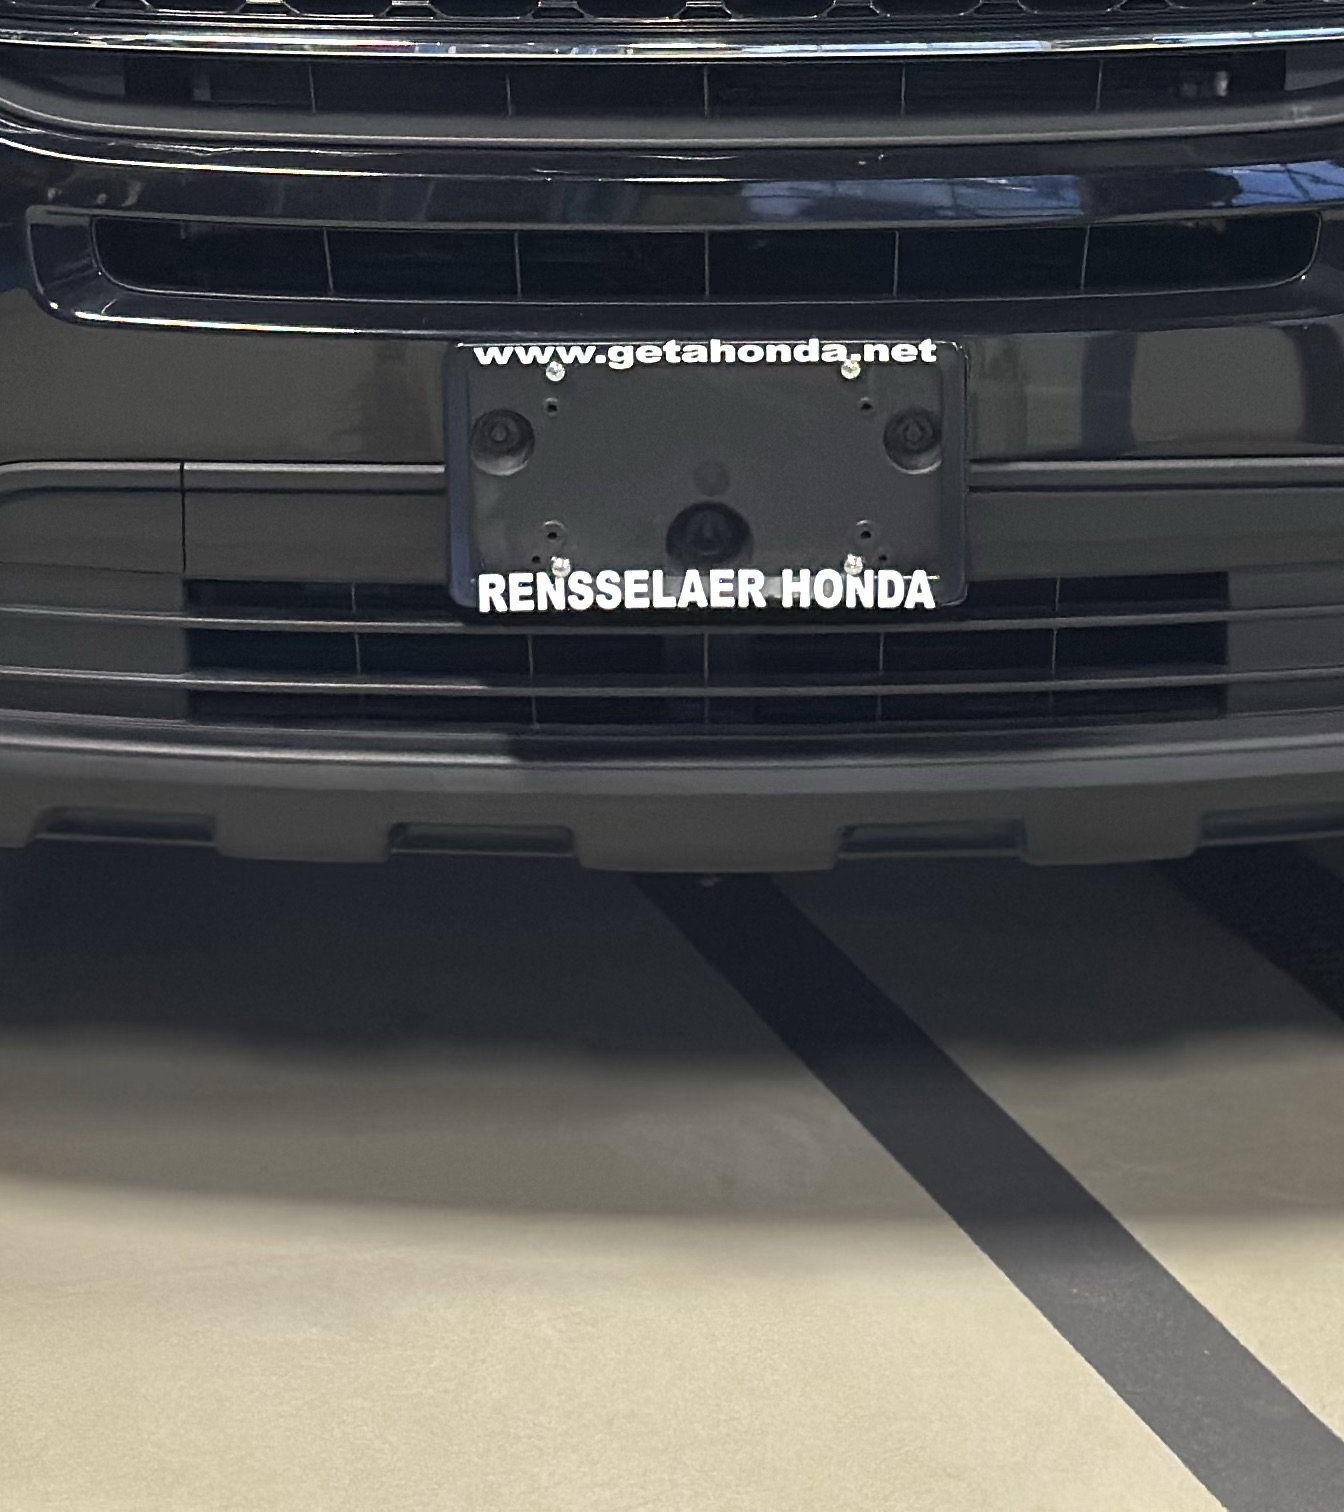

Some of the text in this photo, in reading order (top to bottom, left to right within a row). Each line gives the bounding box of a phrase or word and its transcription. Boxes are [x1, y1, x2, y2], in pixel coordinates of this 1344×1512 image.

[474, 338, 938, 370] www.getahonda.net
[477, 568, 937, 613] RENSSELAER HONDA
